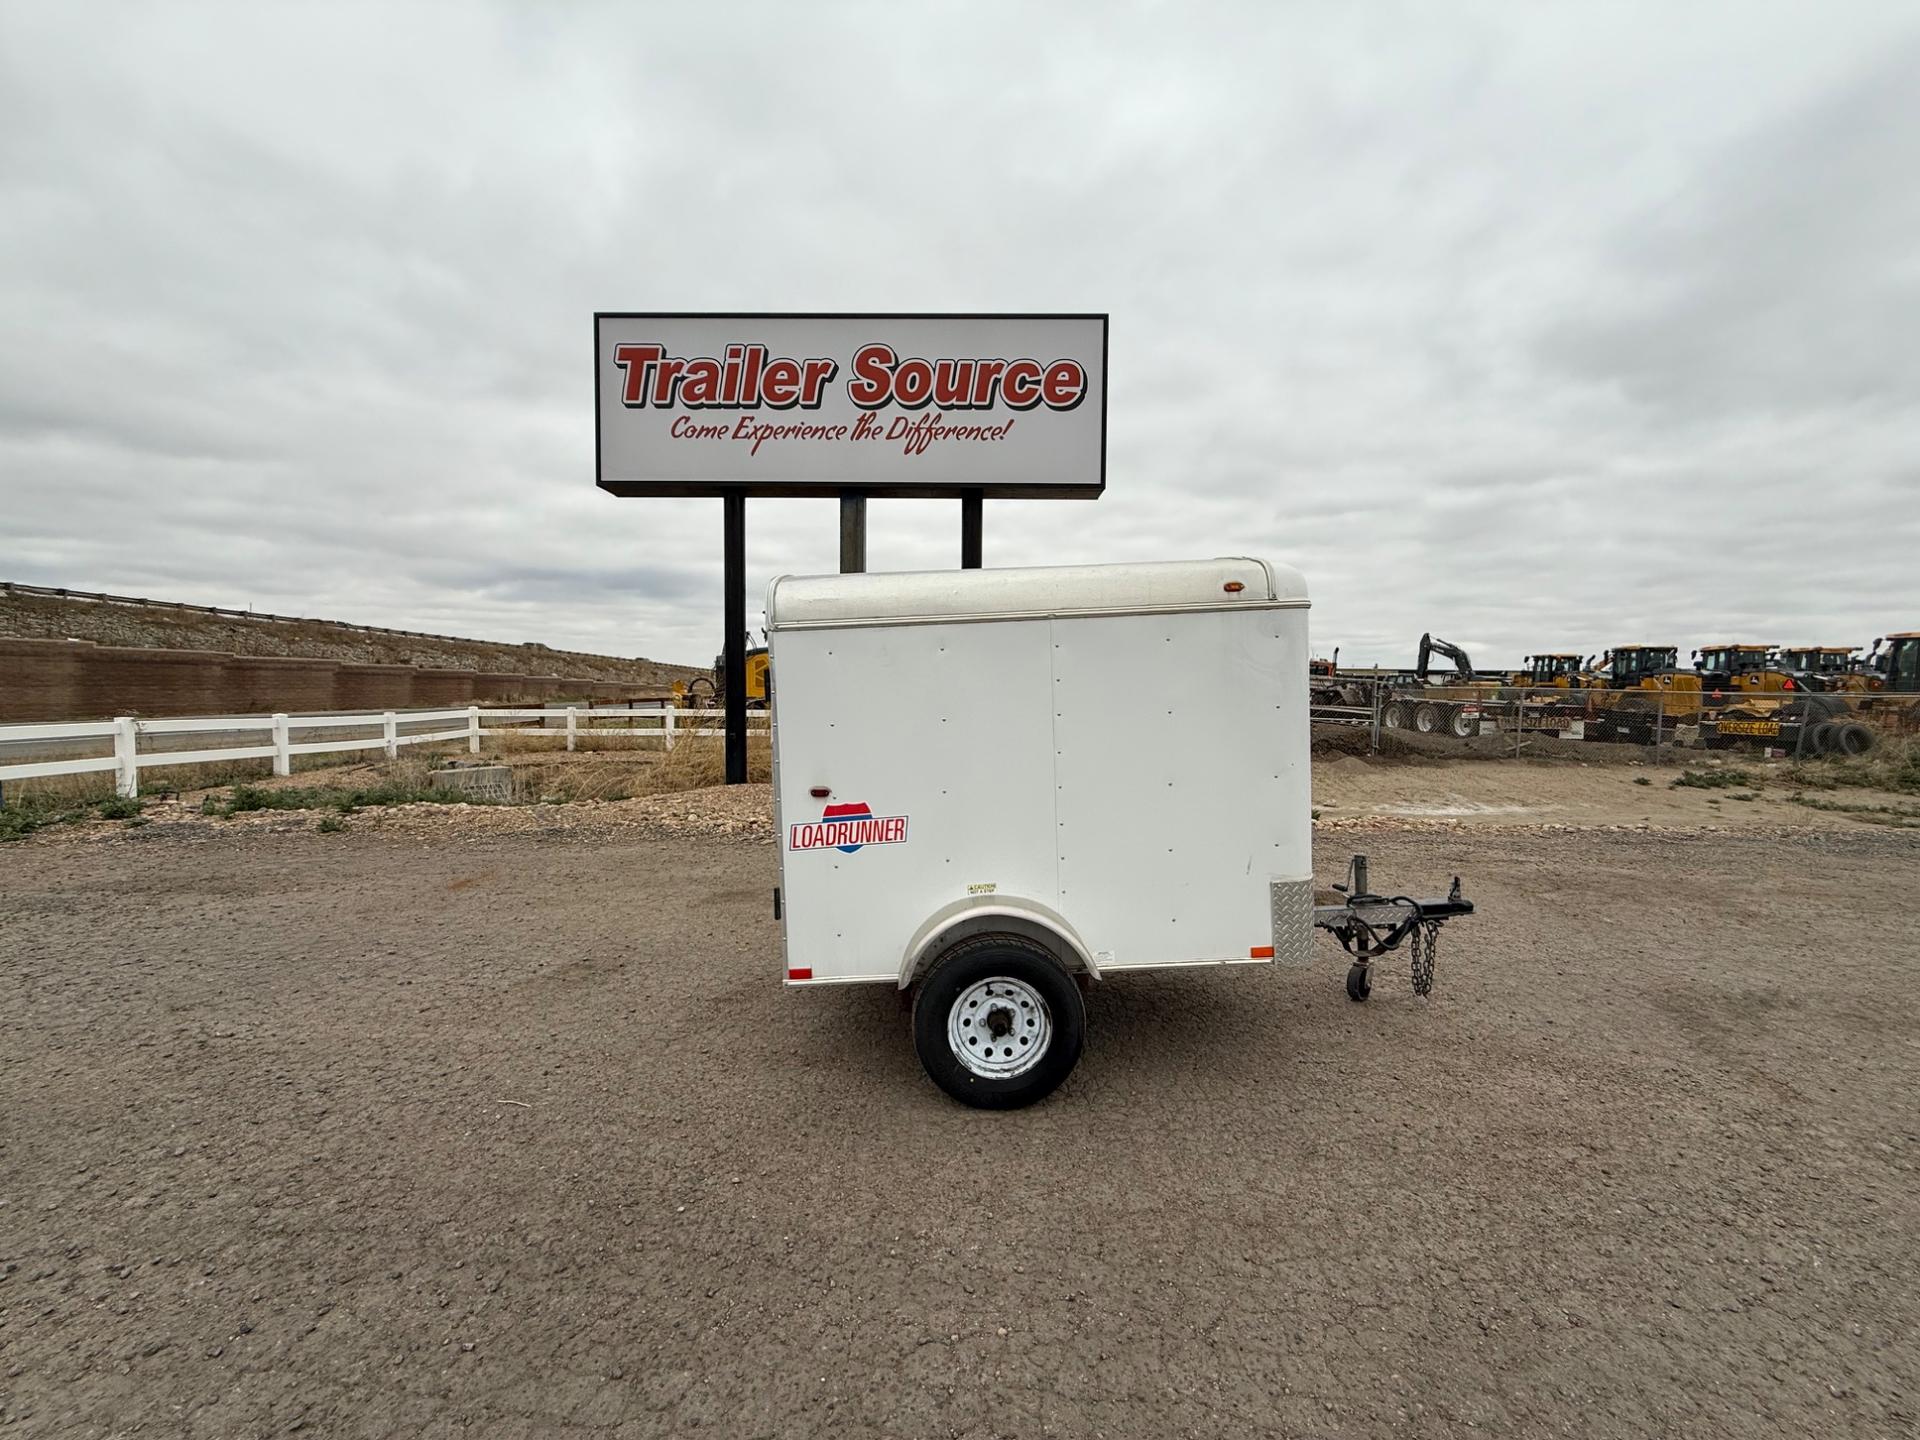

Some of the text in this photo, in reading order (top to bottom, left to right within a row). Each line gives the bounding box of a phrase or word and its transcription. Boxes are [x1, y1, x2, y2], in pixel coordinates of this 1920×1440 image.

[614, 343, 1088, 412] Trailer Source
[671, 411, 1014, 456] Come Experience the Difference!
[1717, 721, 1756, 734] OVERSIZE
[792, 818, 905, 848] LOADRUNNER
